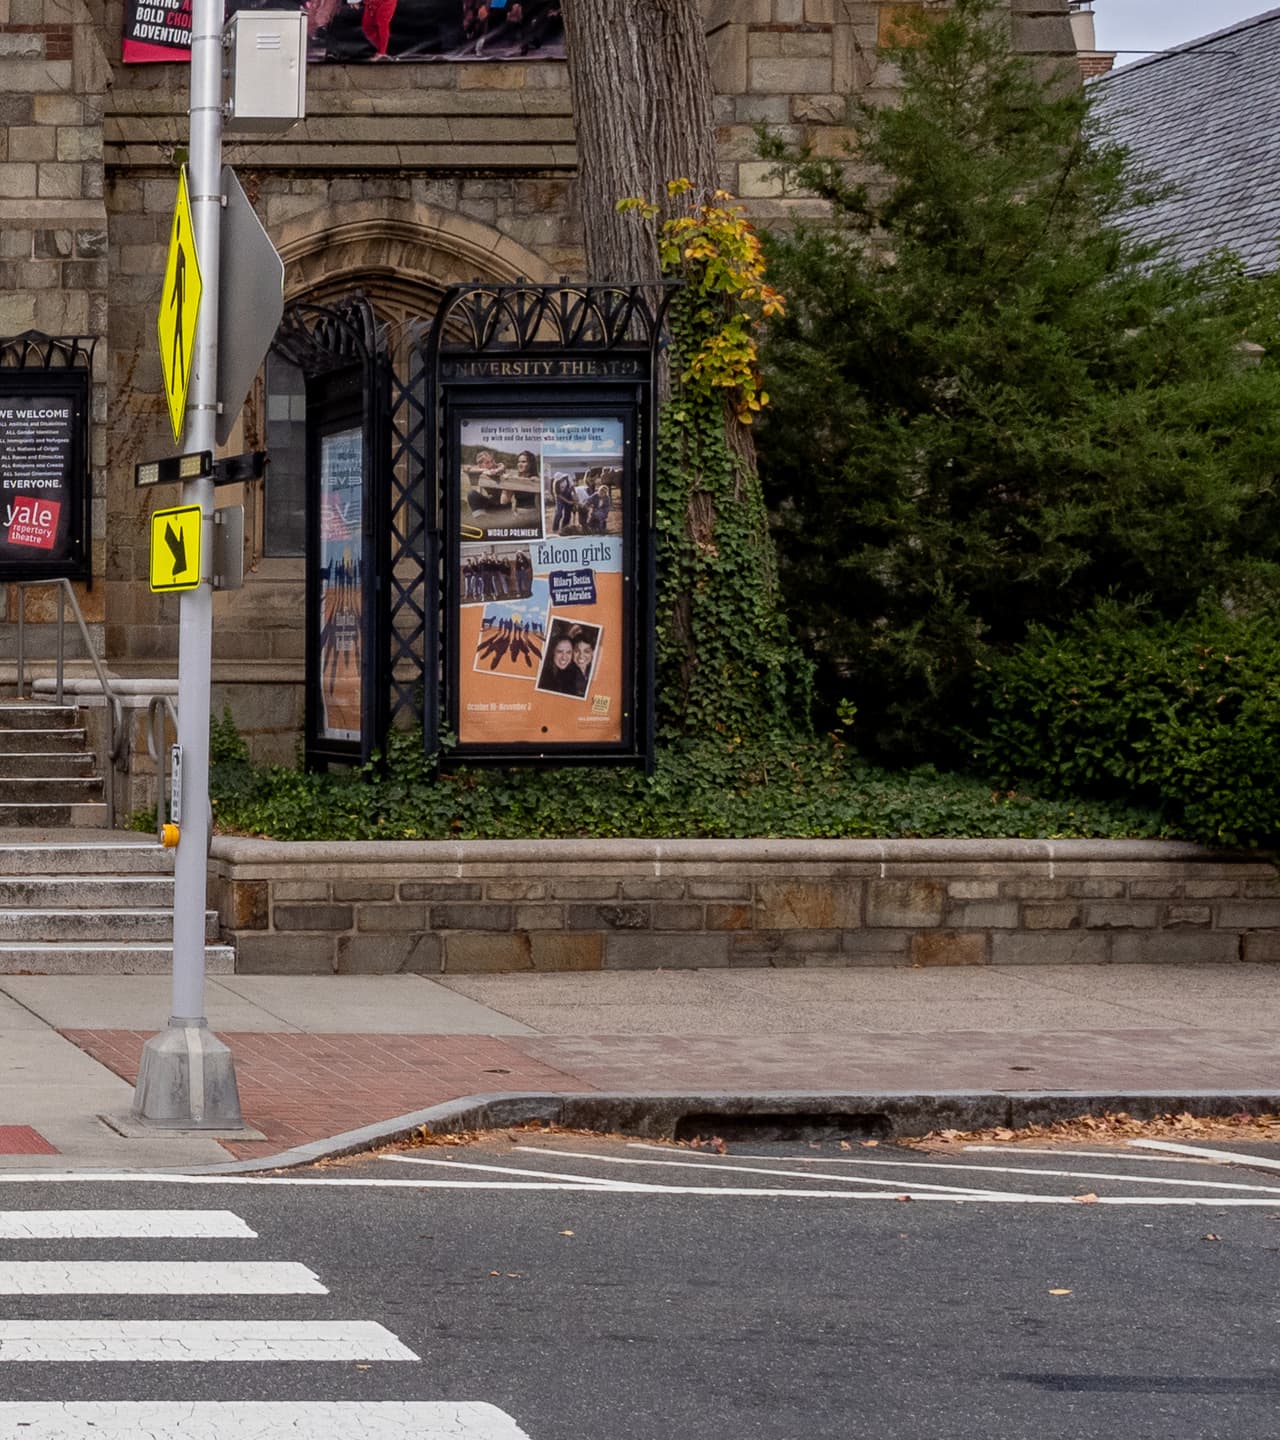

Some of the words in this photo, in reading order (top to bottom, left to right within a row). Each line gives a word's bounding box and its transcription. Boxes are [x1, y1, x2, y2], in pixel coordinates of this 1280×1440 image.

[136, 7, 164, 24] BOLD
[133, 23, 192, 45] ADVENTUR
[441, 361, 552, 376] UNIVERSITY
[16, 410, 68, 418] WELCOME
[3, 479, 62, 488] EVERYONE.
[3, 502, 52, 528] yale
[12, 532, 42, 544] theatre
[13, 524, 52, 539] repertory
[487, 529, 508, 537] WORLD
[538, 542, 578, 565] falcon
[582, 542, 612, 566] girls
